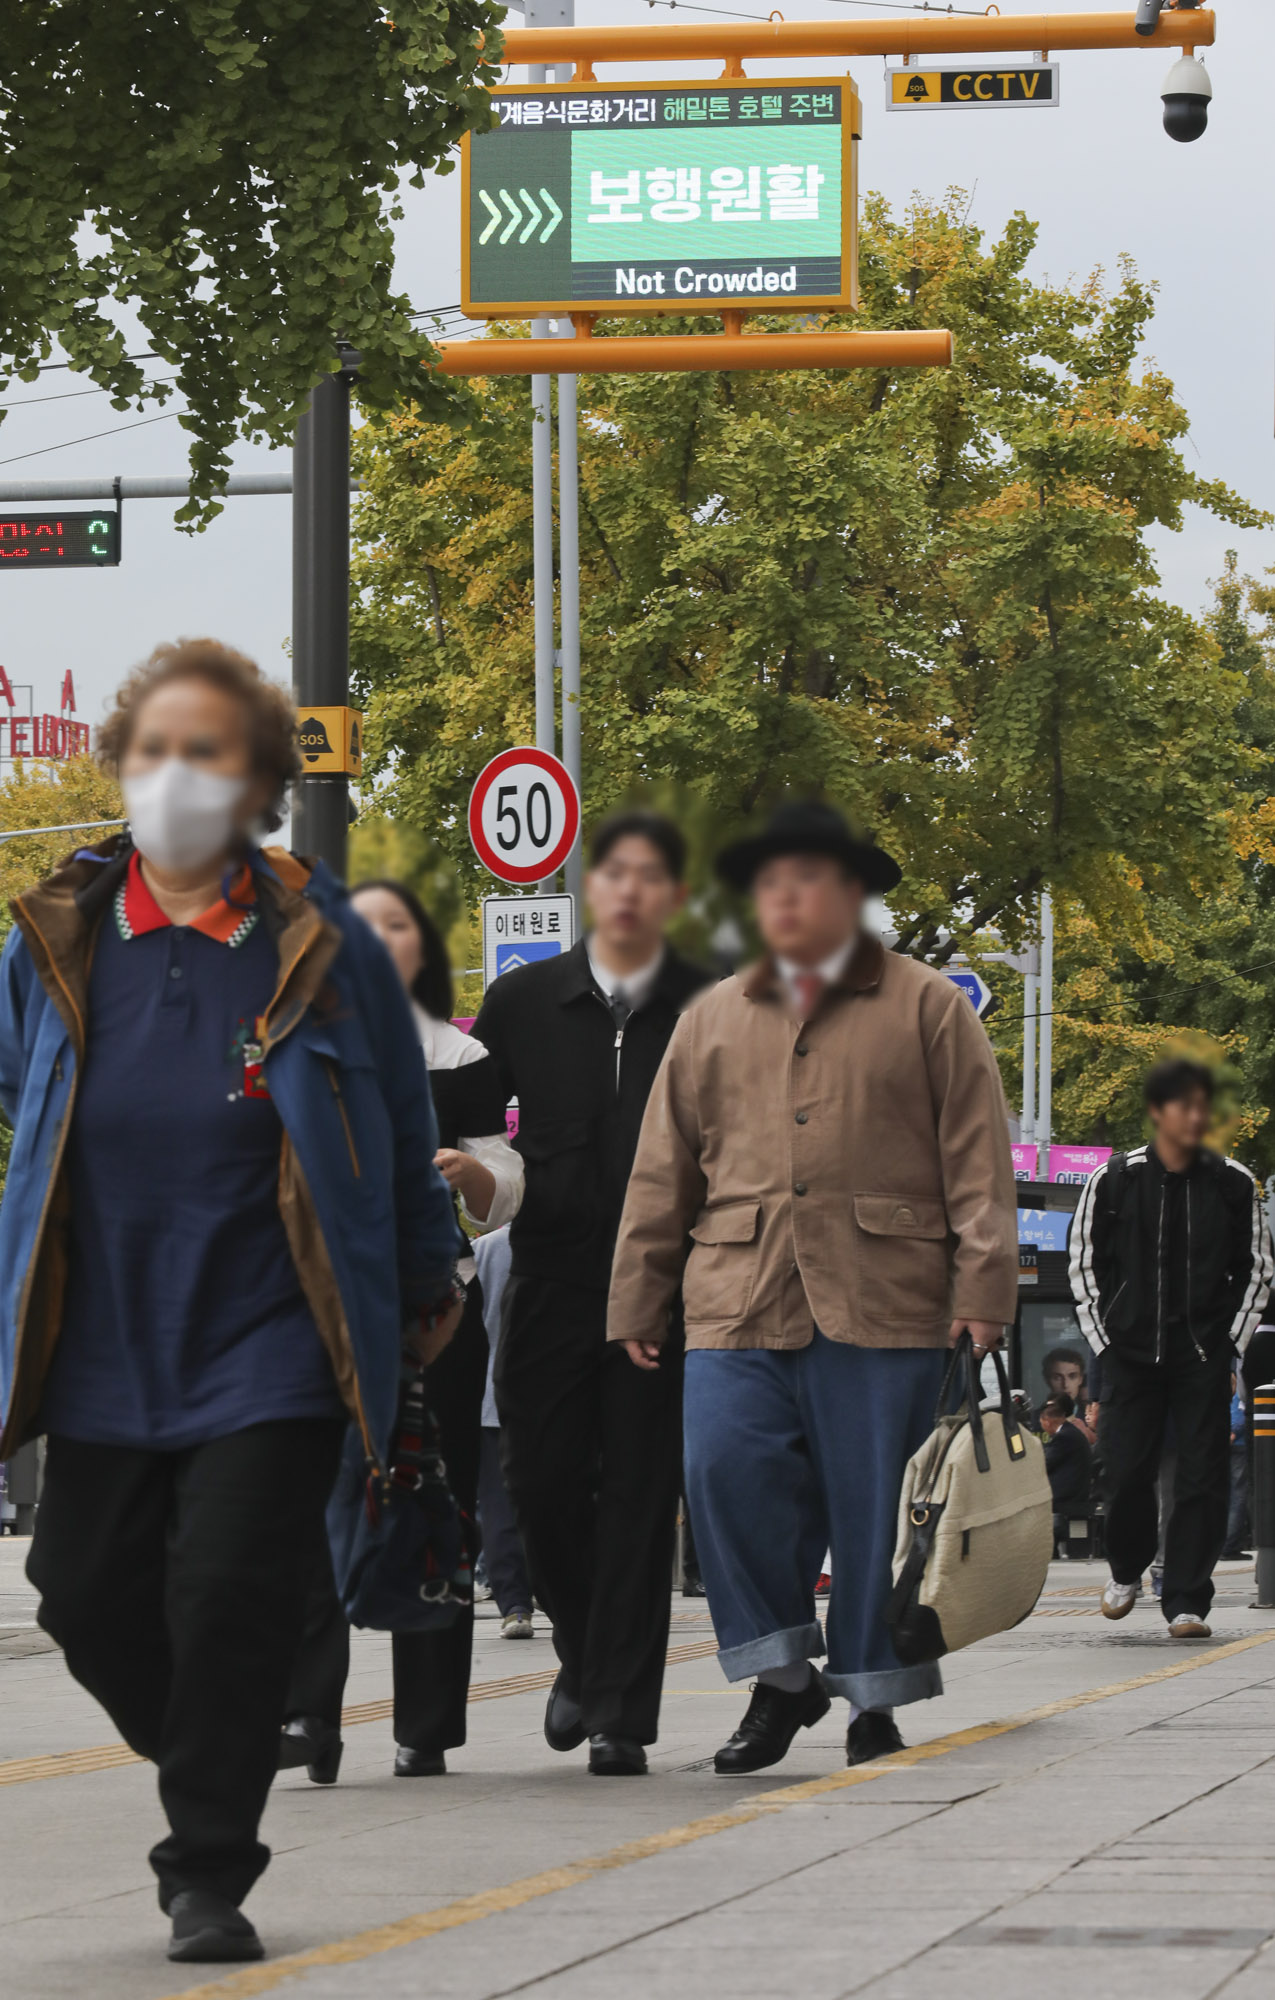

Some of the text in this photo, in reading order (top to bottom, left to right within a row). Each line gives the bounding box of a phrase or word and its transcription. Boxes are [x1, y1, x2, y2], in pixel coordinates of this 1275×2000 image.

[909, 84, 925, 93] SOS
[953, 72, 1040, 101] CCTV
[490, 93, 835, 125] 계음식문화거리 해밀톤 호텔 주변
[587, 164, 825, 223] 보행원활
[615, 265, 797, 295] Not Crowded
[299, 734, 325, 746] SOS
[496, 782, 552, 851] 50
[496, 911, 561, 937] 이태원로
